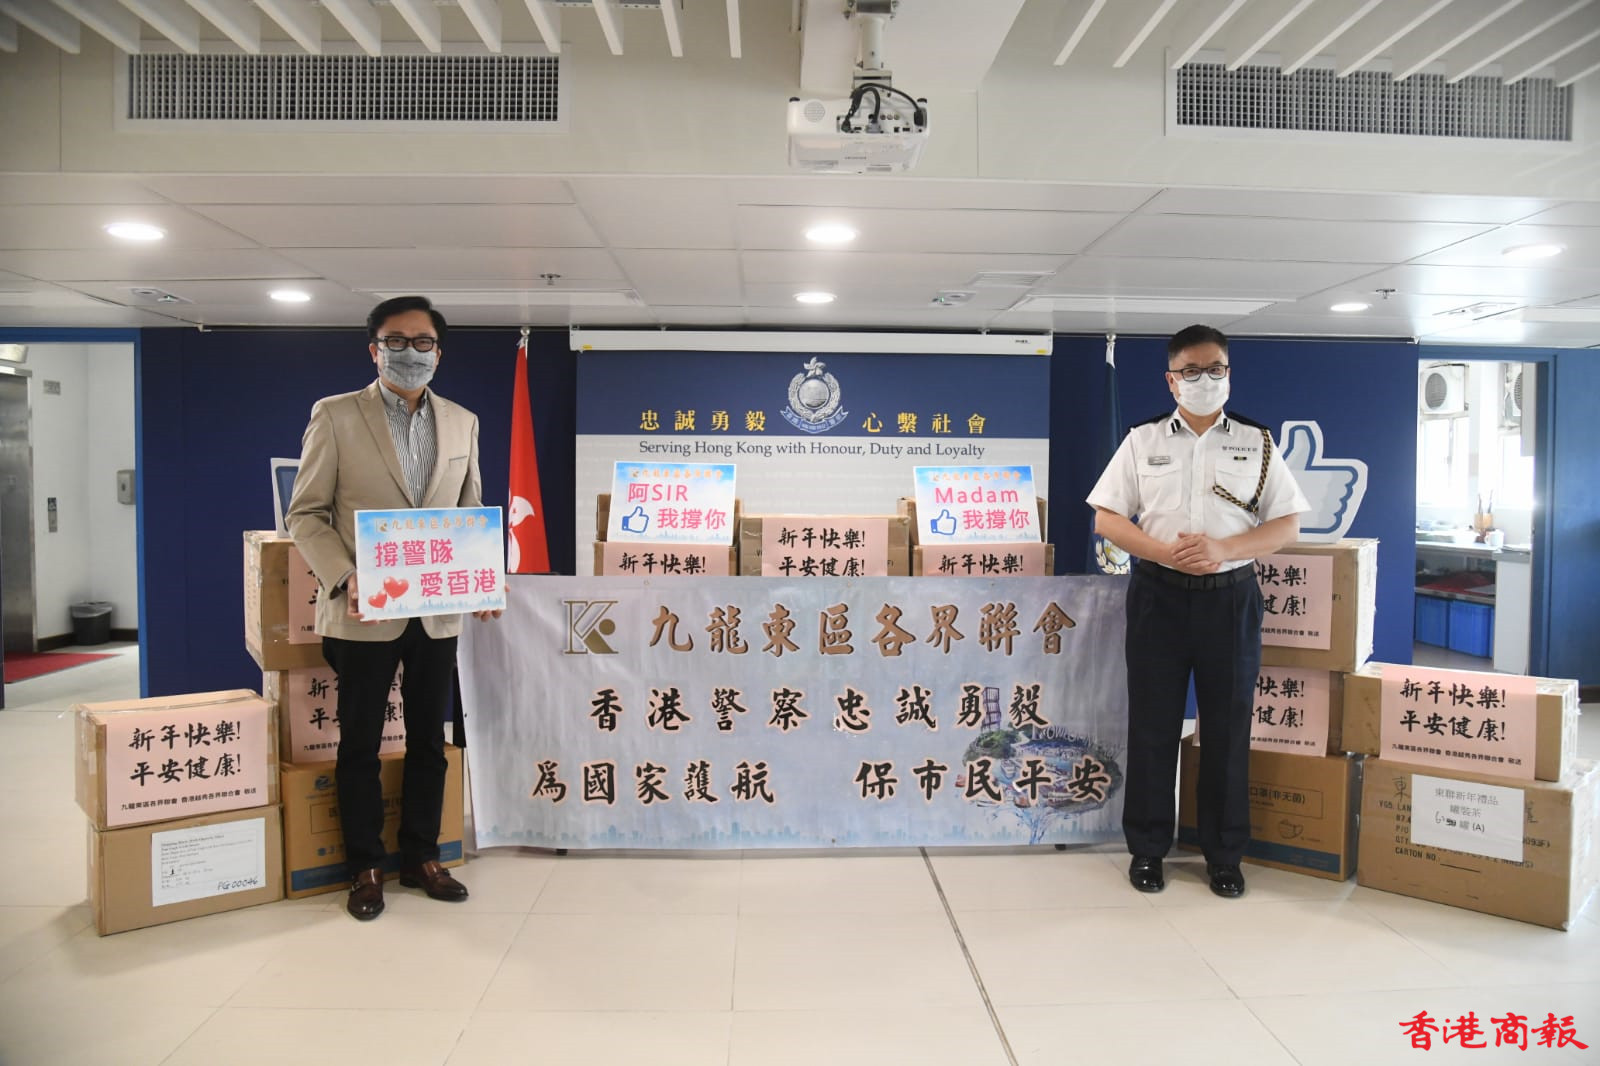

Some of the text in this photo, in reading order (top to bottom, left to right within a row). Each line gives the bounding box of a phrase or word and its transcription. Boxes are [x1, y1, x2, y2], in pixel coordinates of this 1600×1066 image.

[639, 409, 766, 431] 忠誠勇毅
[862, 412, 986, 434] 心繫社會
[639, 440, 985, 459] Serving Hong Kong with Honour, Duty and Loyalty
[628, 483, 689, 503] 阿SIR
[934, 486, 1019, 504] Madam
[657, 508, 726, 530] 我撐你
[962, 508, 1031, 530] 我撐你
[777, 528, 865, 549] 新年快樂!
[374, 539, 454, 568] 撐警隊
[619, 552, 706, 575] 新年快樂!
[938, 553, 1024, 575] 新年快樂!
[778, 556, 865, 577] 平安健康!
[1257, 564, 1307, 586] 快樂!
[420, 568, 496, 597] 愛香港
[1263, 594, 1307, 616] 健康!
[649, 602, 1077, 657] 九龍東區各界聯會
[1255, 675, 1305, 699] 快樂!
[1400, 678, 1506, 709] 新年快樂!
[590, 684, 1050, 732] 香港警察忠誠勇毅
[1252, 705, 1304, 728] 健康!
[129, 720, 241, 752] 新年快樂!
[1400, 710, 1506, 742] 平安健康!
[130, 753, 241, 786] 平安健康!
[854, 758, 1109, 801] 保市民平安
[1395, 846, 1423, 859] CARTON
